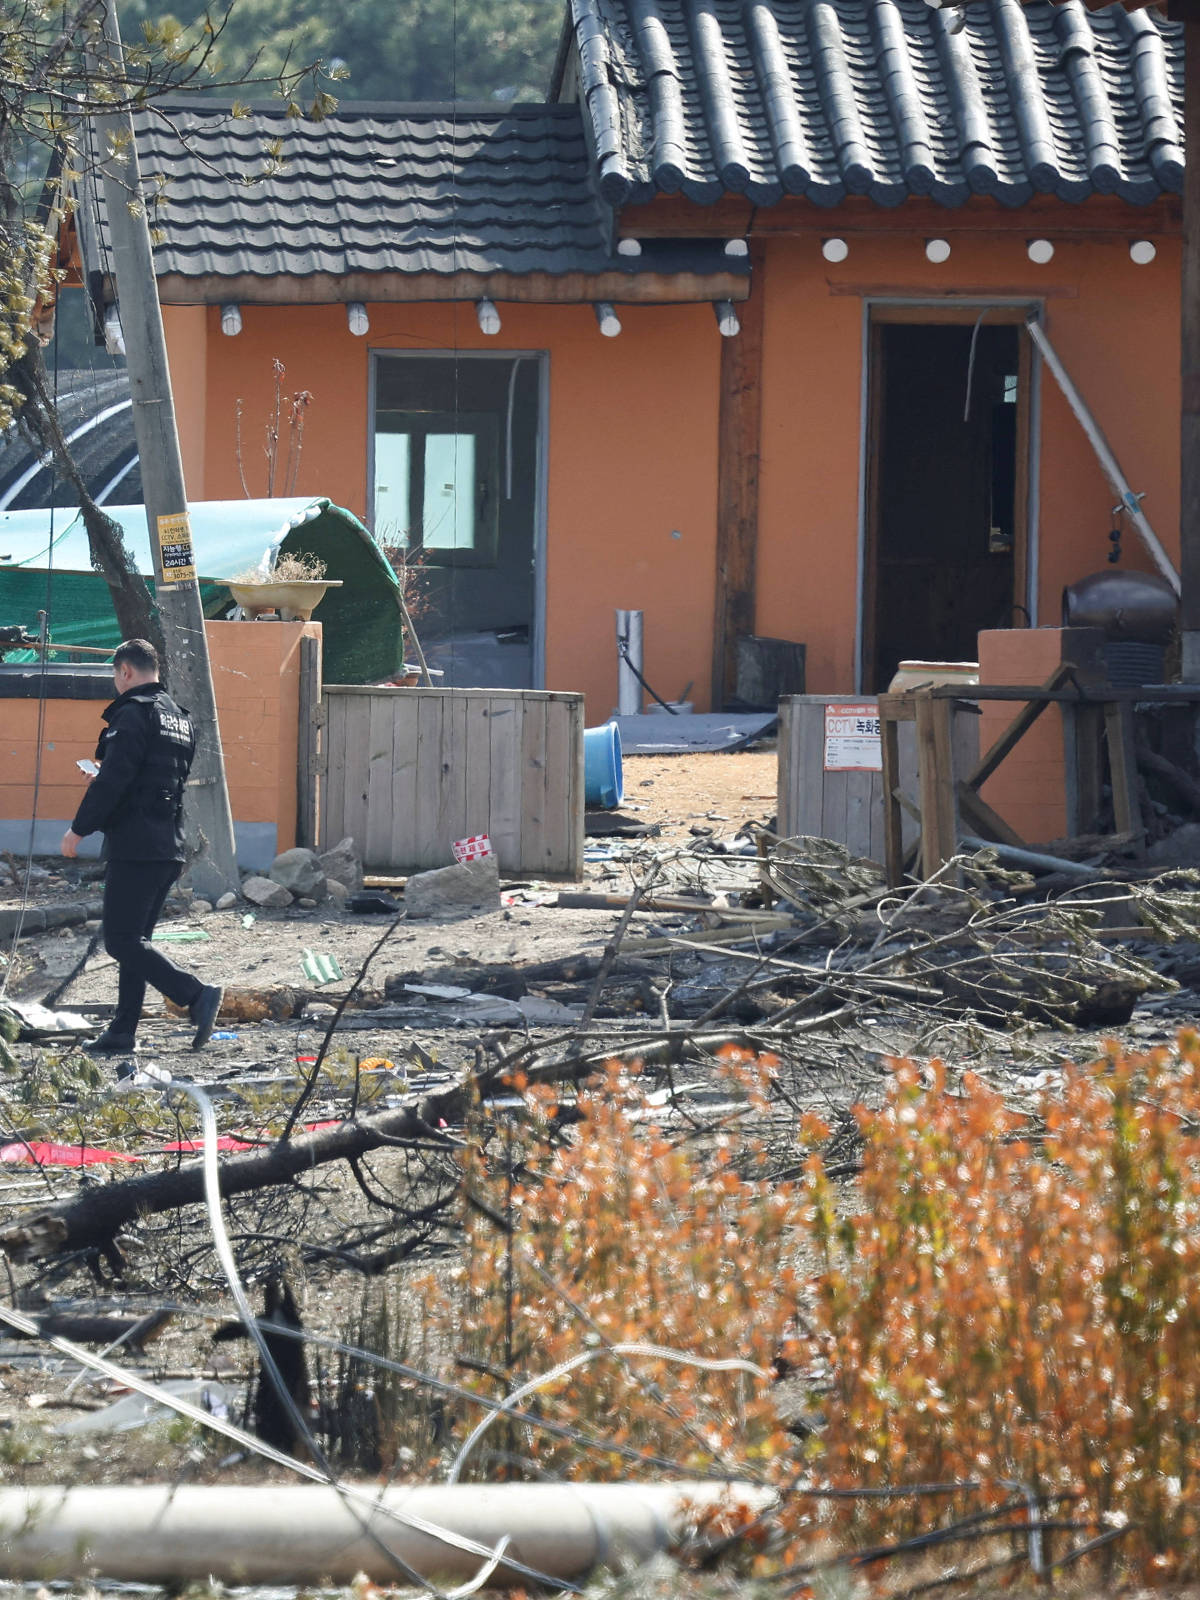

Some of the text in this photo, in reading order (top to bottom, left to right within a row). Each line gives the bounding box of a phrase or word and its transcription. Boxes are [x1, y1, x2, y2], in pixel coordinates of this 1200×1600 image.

[165, 558, 187, 567] 24시간
[828, 718, 881, 735] CCTV 녹화중
